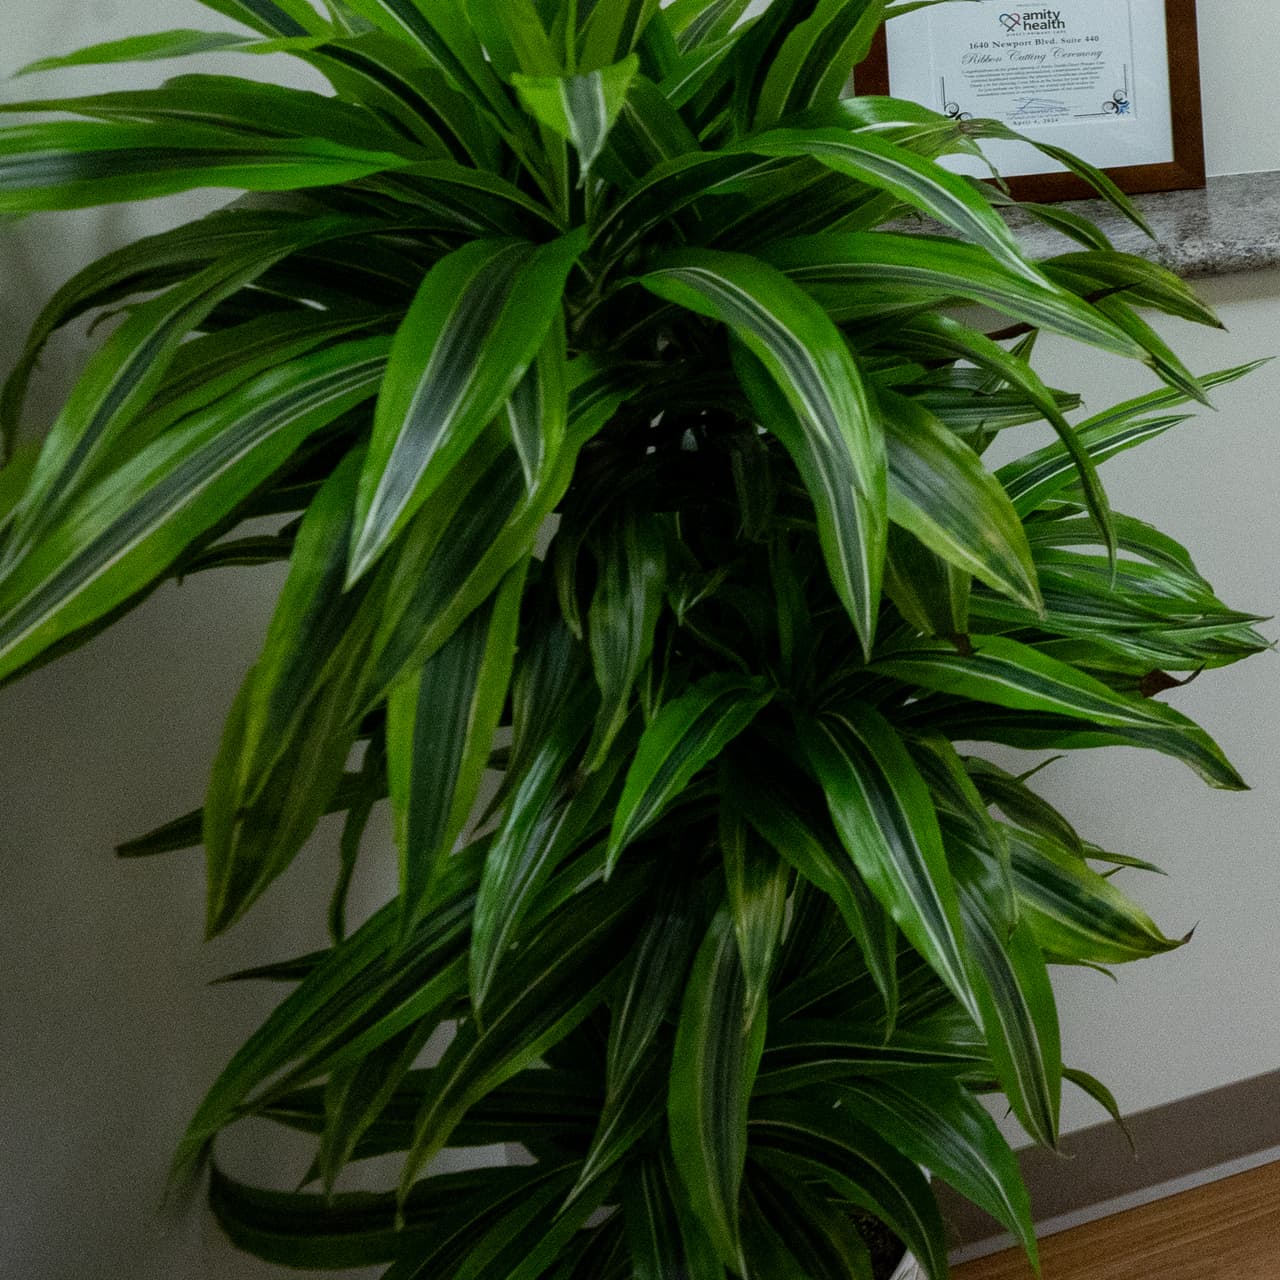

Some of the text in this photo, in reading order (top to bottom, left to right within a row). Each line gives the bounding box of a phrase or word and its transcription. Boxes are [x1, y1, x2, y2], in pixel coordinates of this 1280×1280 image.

[1022, 8, 1061, 22] amity
[1023, 19, 1066, 31] health
[969, 35, 1100, 50] 1640 Newport Blvd. Suite 440
[961, 46, 1103, 65] Ribbon Cutting Ceremony
